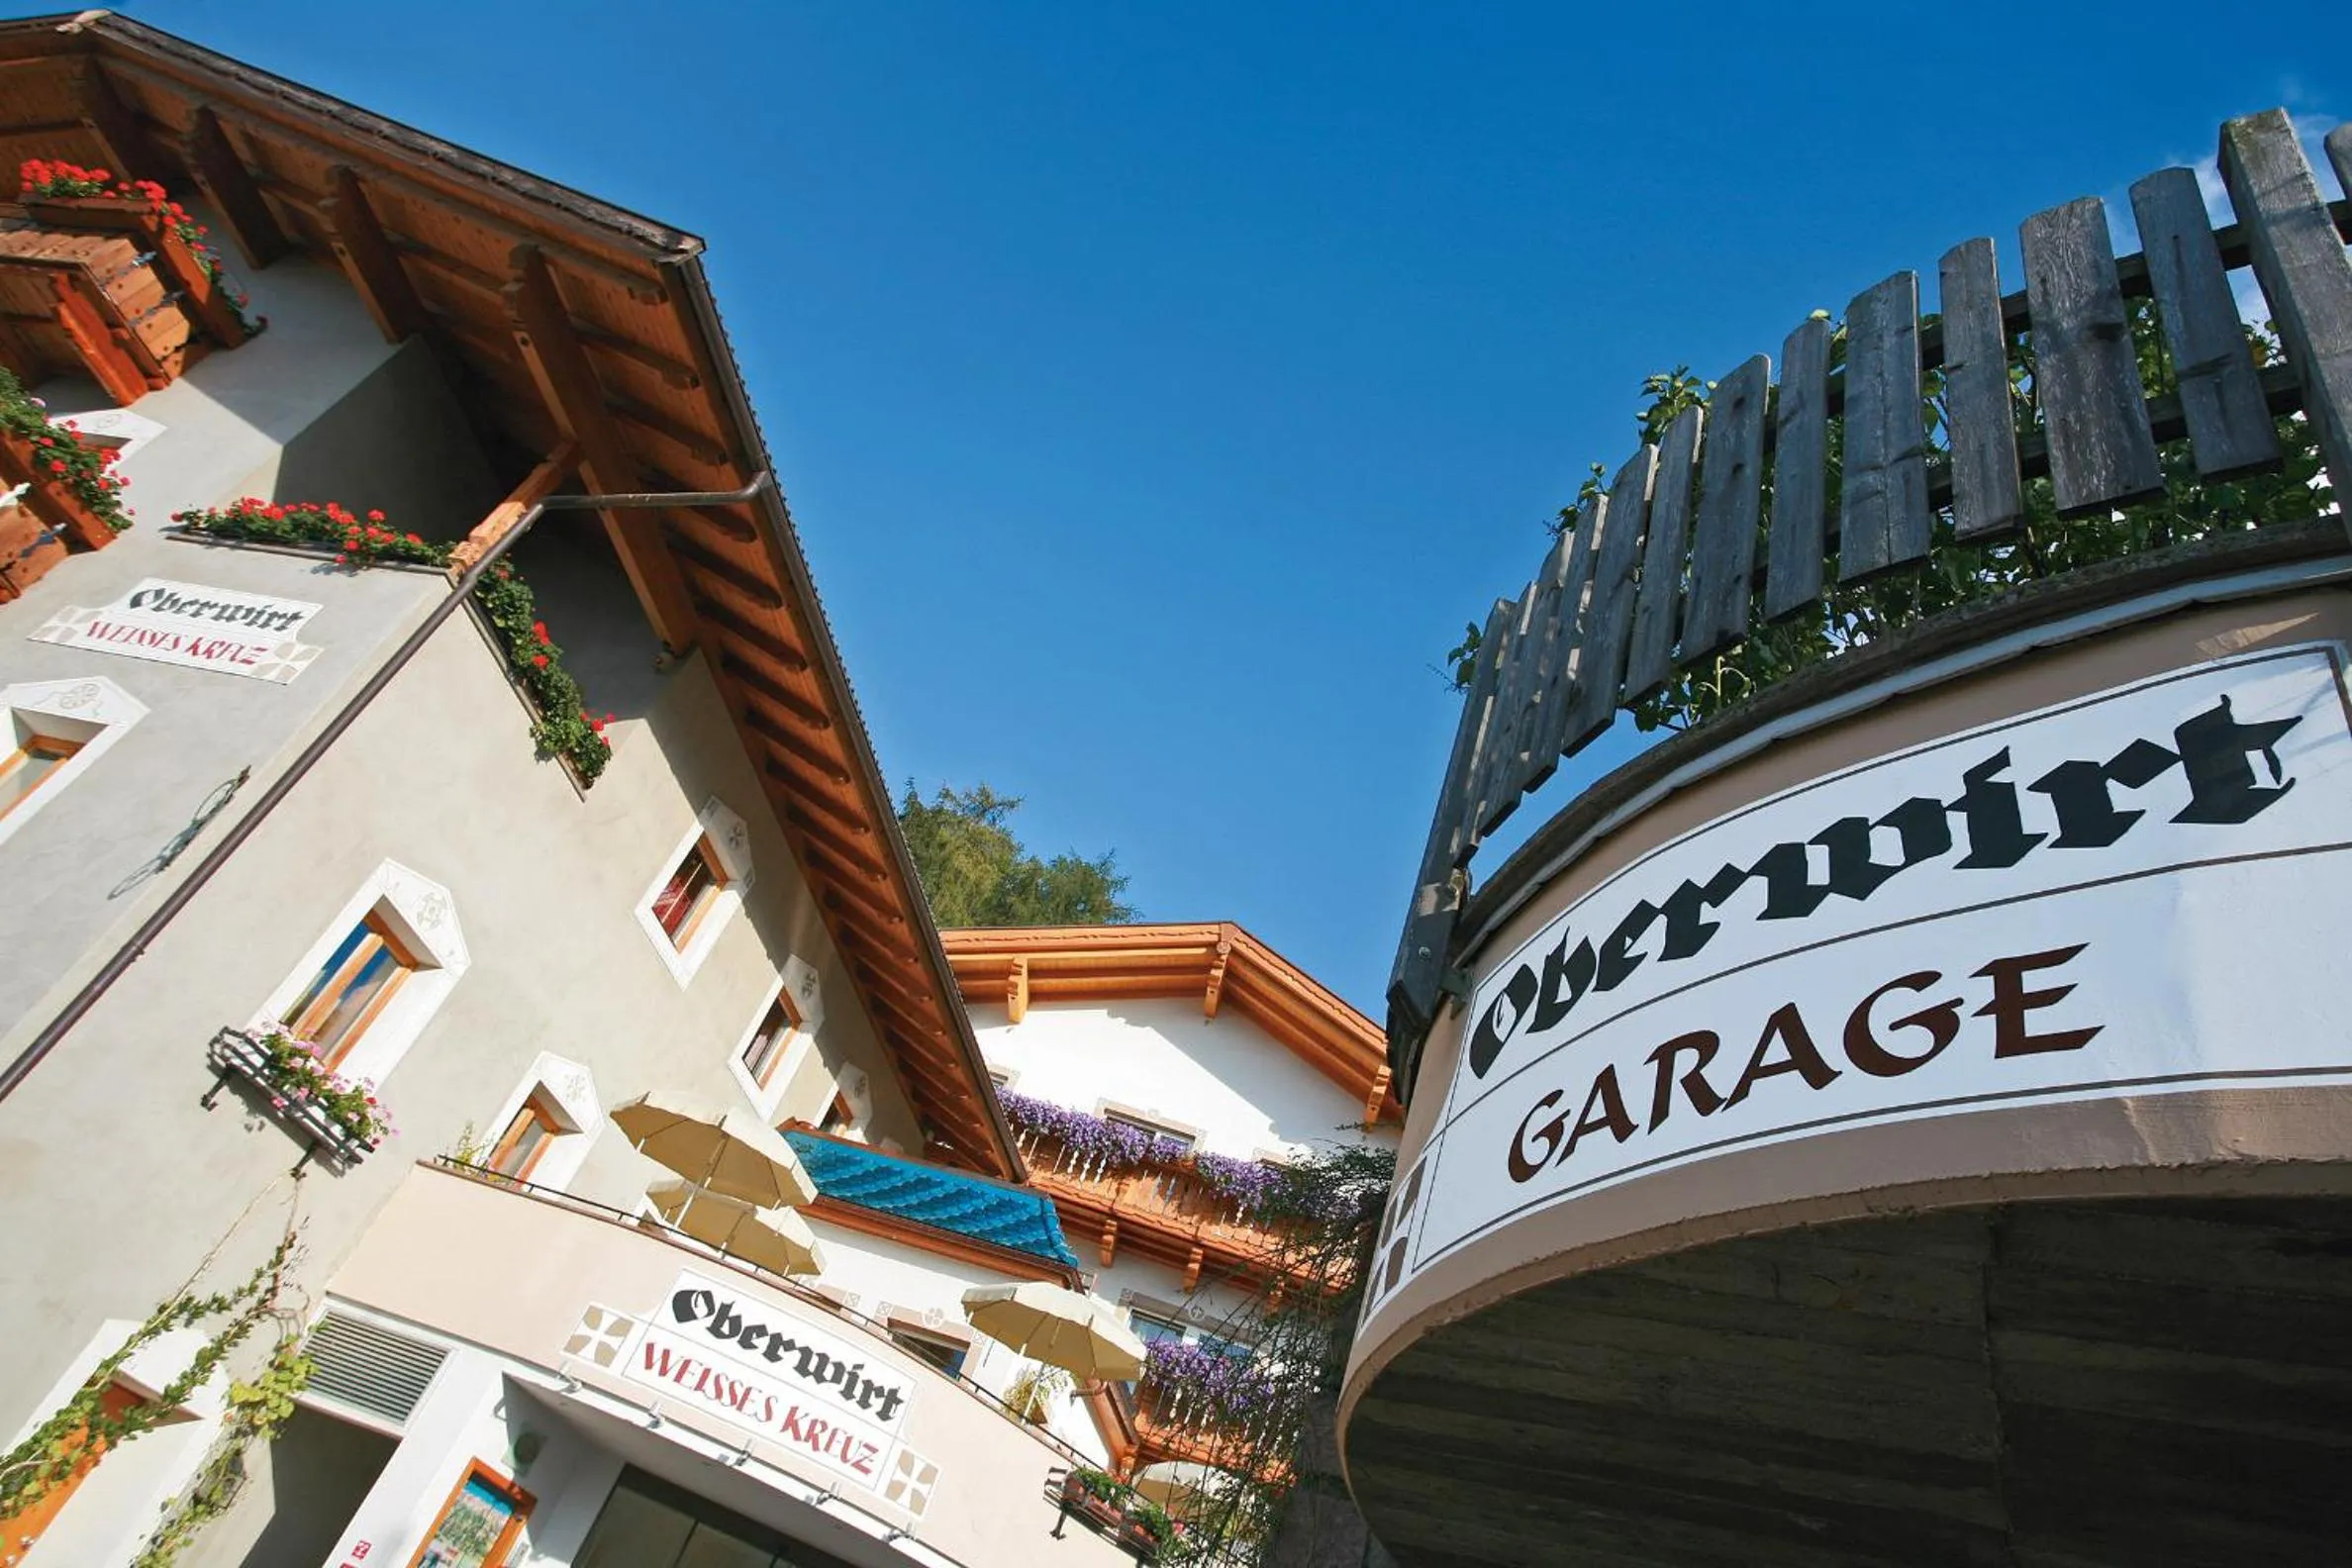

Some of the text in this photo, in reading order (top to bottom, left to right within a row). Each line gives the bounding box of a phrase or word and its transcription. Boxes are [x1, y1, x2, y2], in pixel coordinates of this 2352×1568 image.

[86, 621, 268, 665] WEISSES KREUZ
[129, 588, 303, 632] Oberwirt
[1469, 694, 2303, 1079] Oberwirt
[1508, 942, 2105, 1182] GARAGE
[642, 1341, 880, 1475] WEISSES KREUZ
[672, 1289, 904, 1421] Oberwirt
